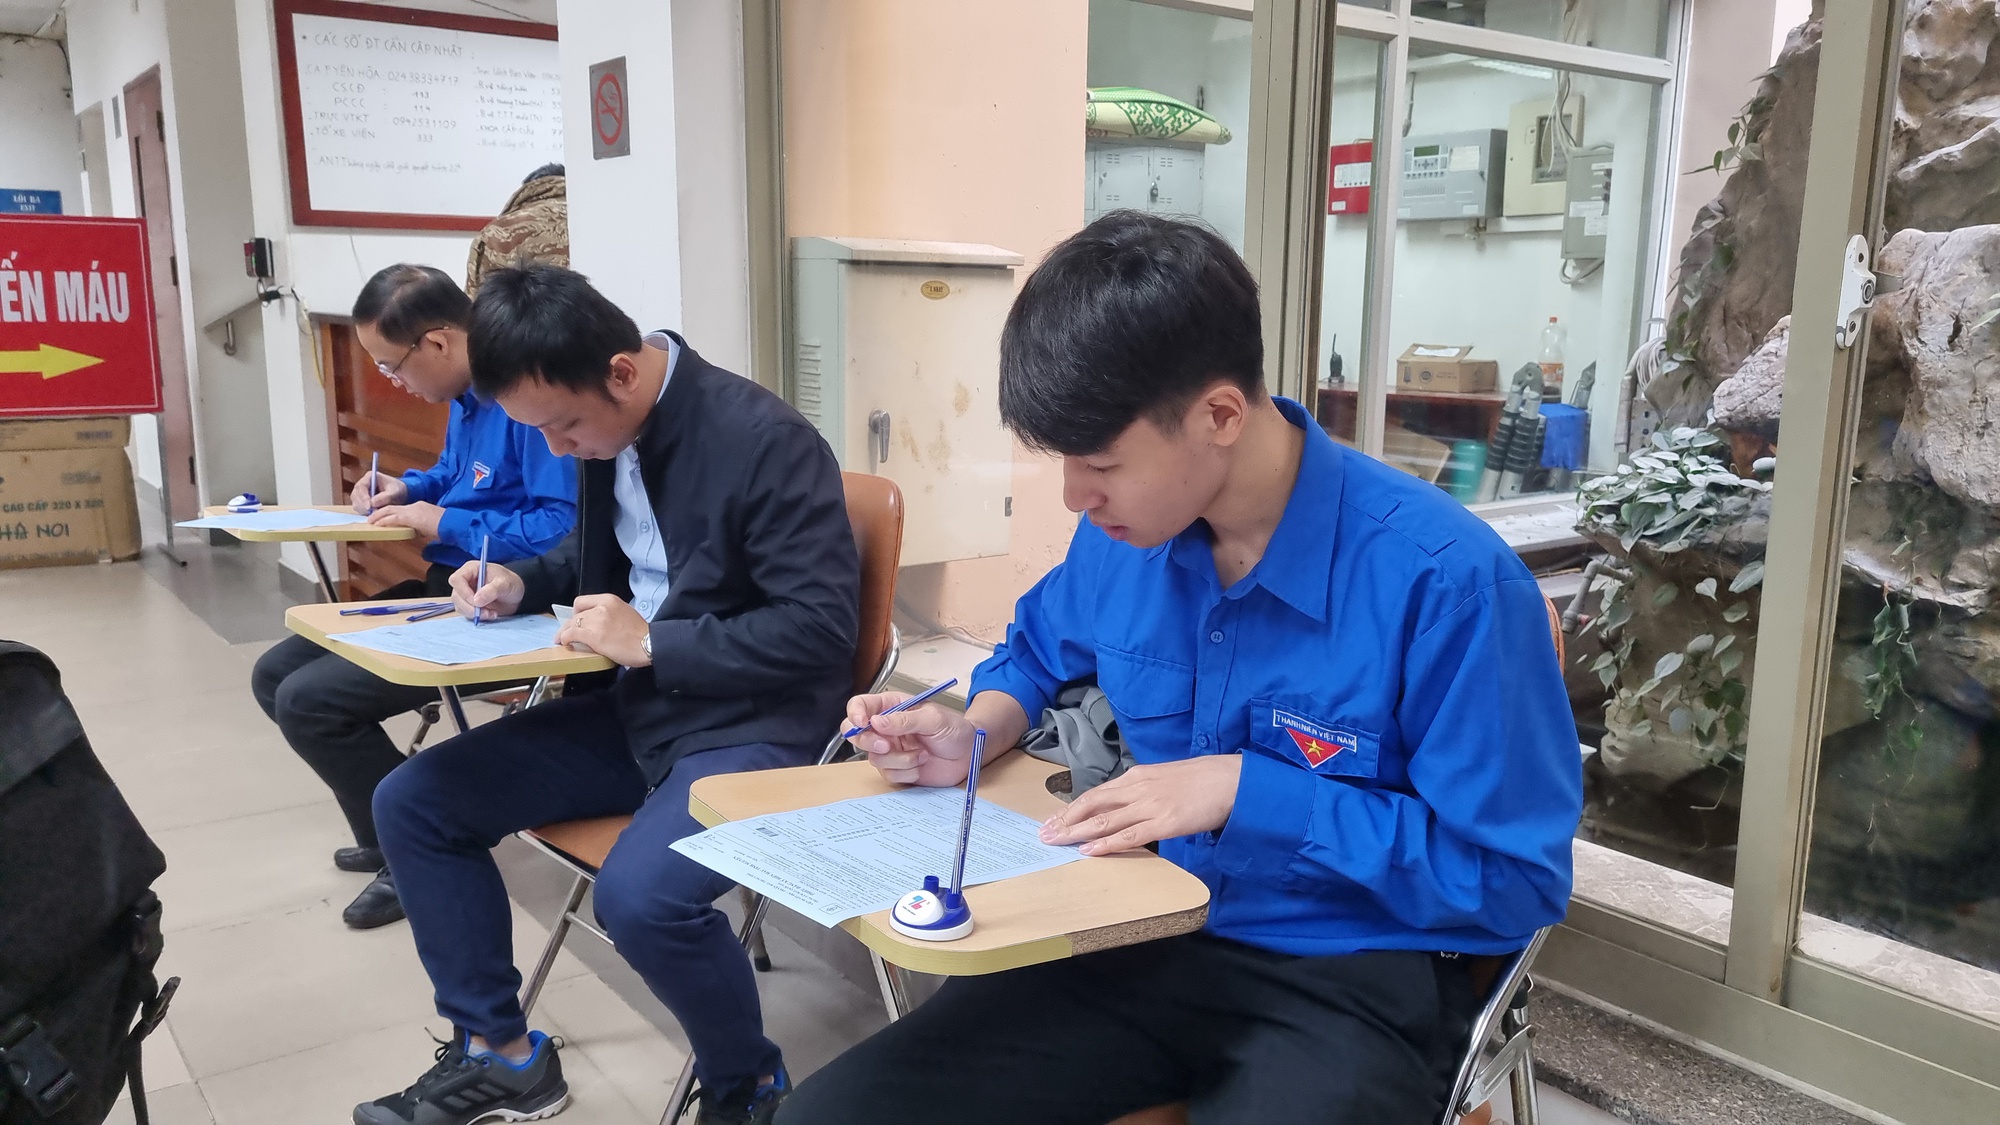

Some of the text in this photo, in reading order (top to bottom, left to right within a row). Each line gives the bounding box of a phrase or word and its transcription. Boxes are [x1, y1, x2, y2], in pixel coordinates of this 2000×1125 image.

[314, 31, 338, 47] CÁC
[344, 33, 362, 49] SỐ
[365, 36, 381, 50] ĐT
[332, 81, 365, 94] CSCĐ
[333, 97, 366, 109] PCCC
[0, 250, 130, 323] ẾN MÁU
[1276, 714, 1300, 729] THANH
[1319, 731, 1335, 741] VIỆT
[1337, 736, 1355, 747] NAM
